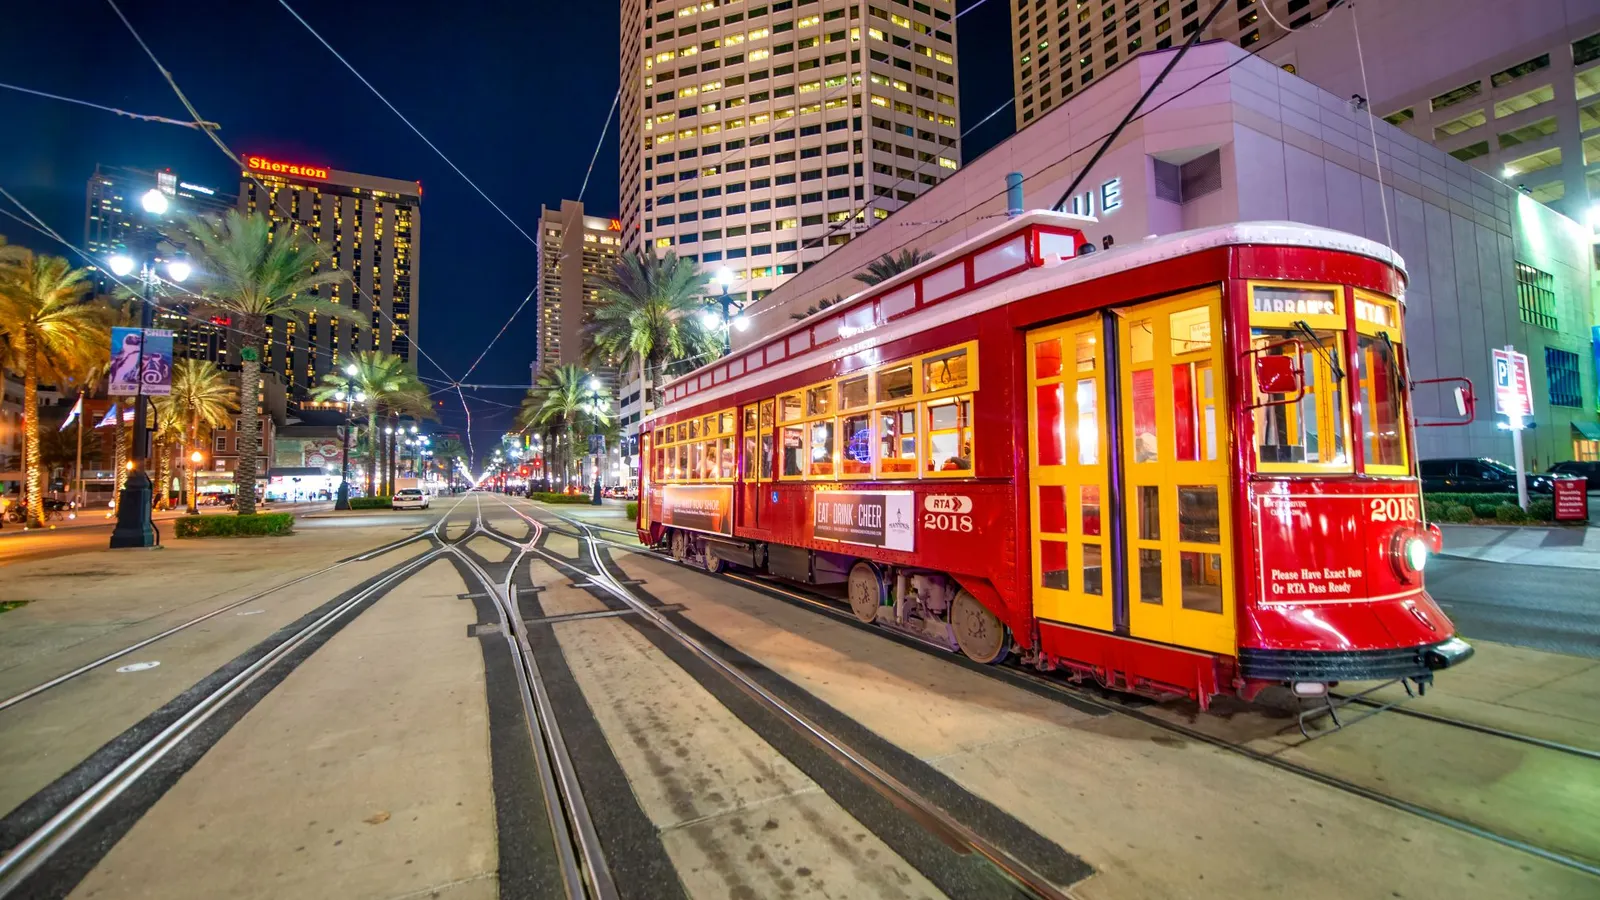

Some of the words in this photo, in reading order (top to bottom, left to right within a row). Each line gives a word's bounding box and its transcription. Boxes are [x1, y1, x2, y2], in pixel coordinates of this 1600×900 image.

[249, 157, 328, 179] Sheraton
[1499, 361, 1507, 384] P
[933, 499, 950, 509] RTA
[1370, 498, 1415, 521] 2018
[818, 502, 829, 523] EAT
[833, 503, 853, 526] DRINK
[858, 504, 881, 528] CHEER
[924, 514, 973, 533] 2018
[1271, 569, 1298, 580] Please
[1301, 569, 1321, 580] Have
[1324, 568, 1346, 579] Exact
[1347, 567, 1362, 578] Fare
[1272, 583, 1284, 594] Or
[1287, 583, 1306, 594] RTA
[1309, 582, 1326, 593] Pass
[1328, 582, 1351, 594] Ready
